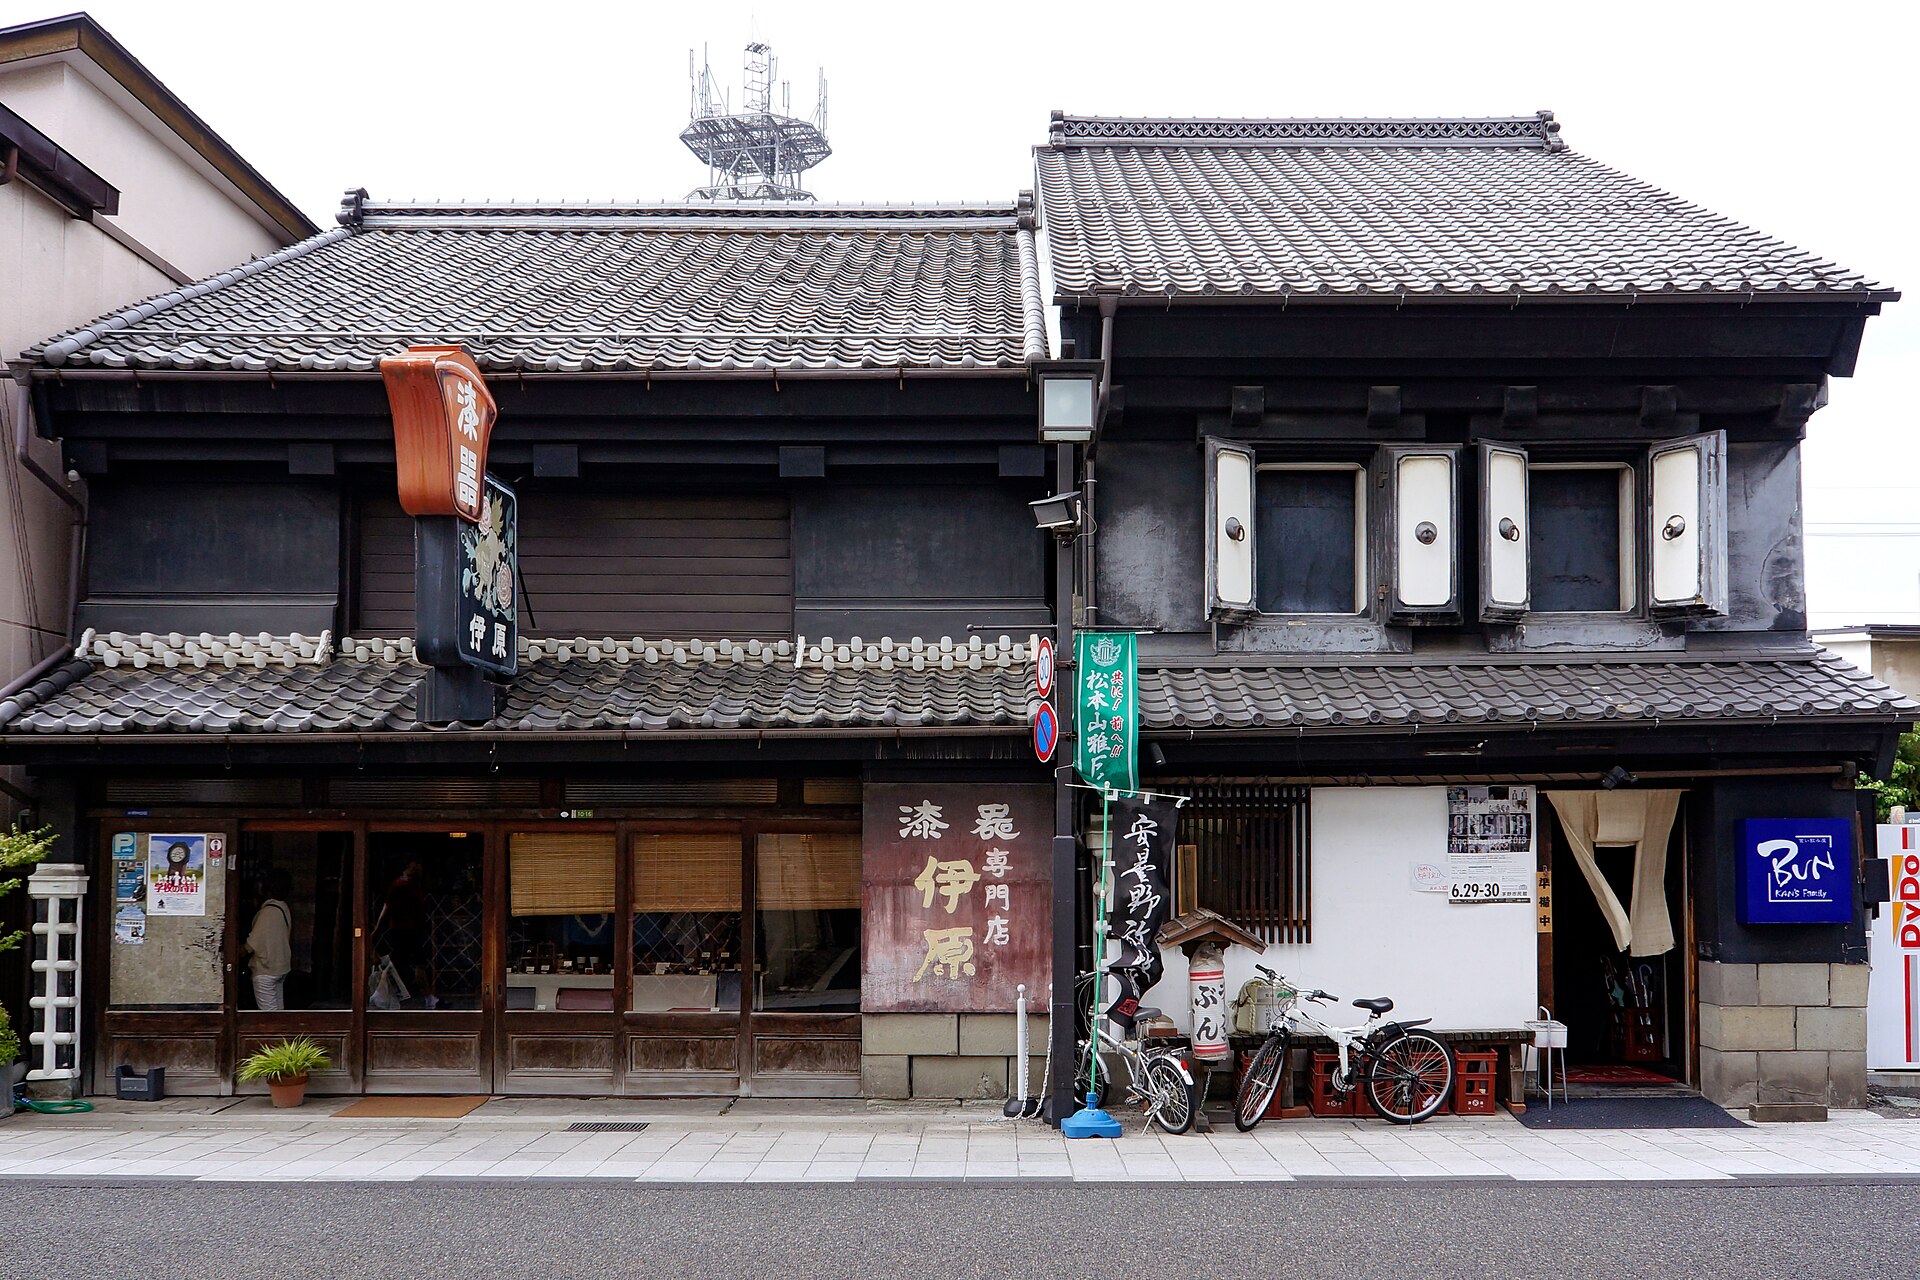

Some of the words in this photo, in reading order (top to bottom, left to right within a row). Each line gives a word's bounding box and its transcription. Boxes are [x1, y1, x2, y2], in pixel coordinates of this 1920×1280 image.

[469, 613, 507, 659] 伊原
[1039, 654, 1049, 681] 30
[1085, 669, 1112, 781] 松本山雅F
[114, 833, 134, 853] P
[1451, 883, 1500, 898] 6.29-30
[912, 855, 982, 983] 伊原
[1194, 984, 1219, 1042] ぶん
